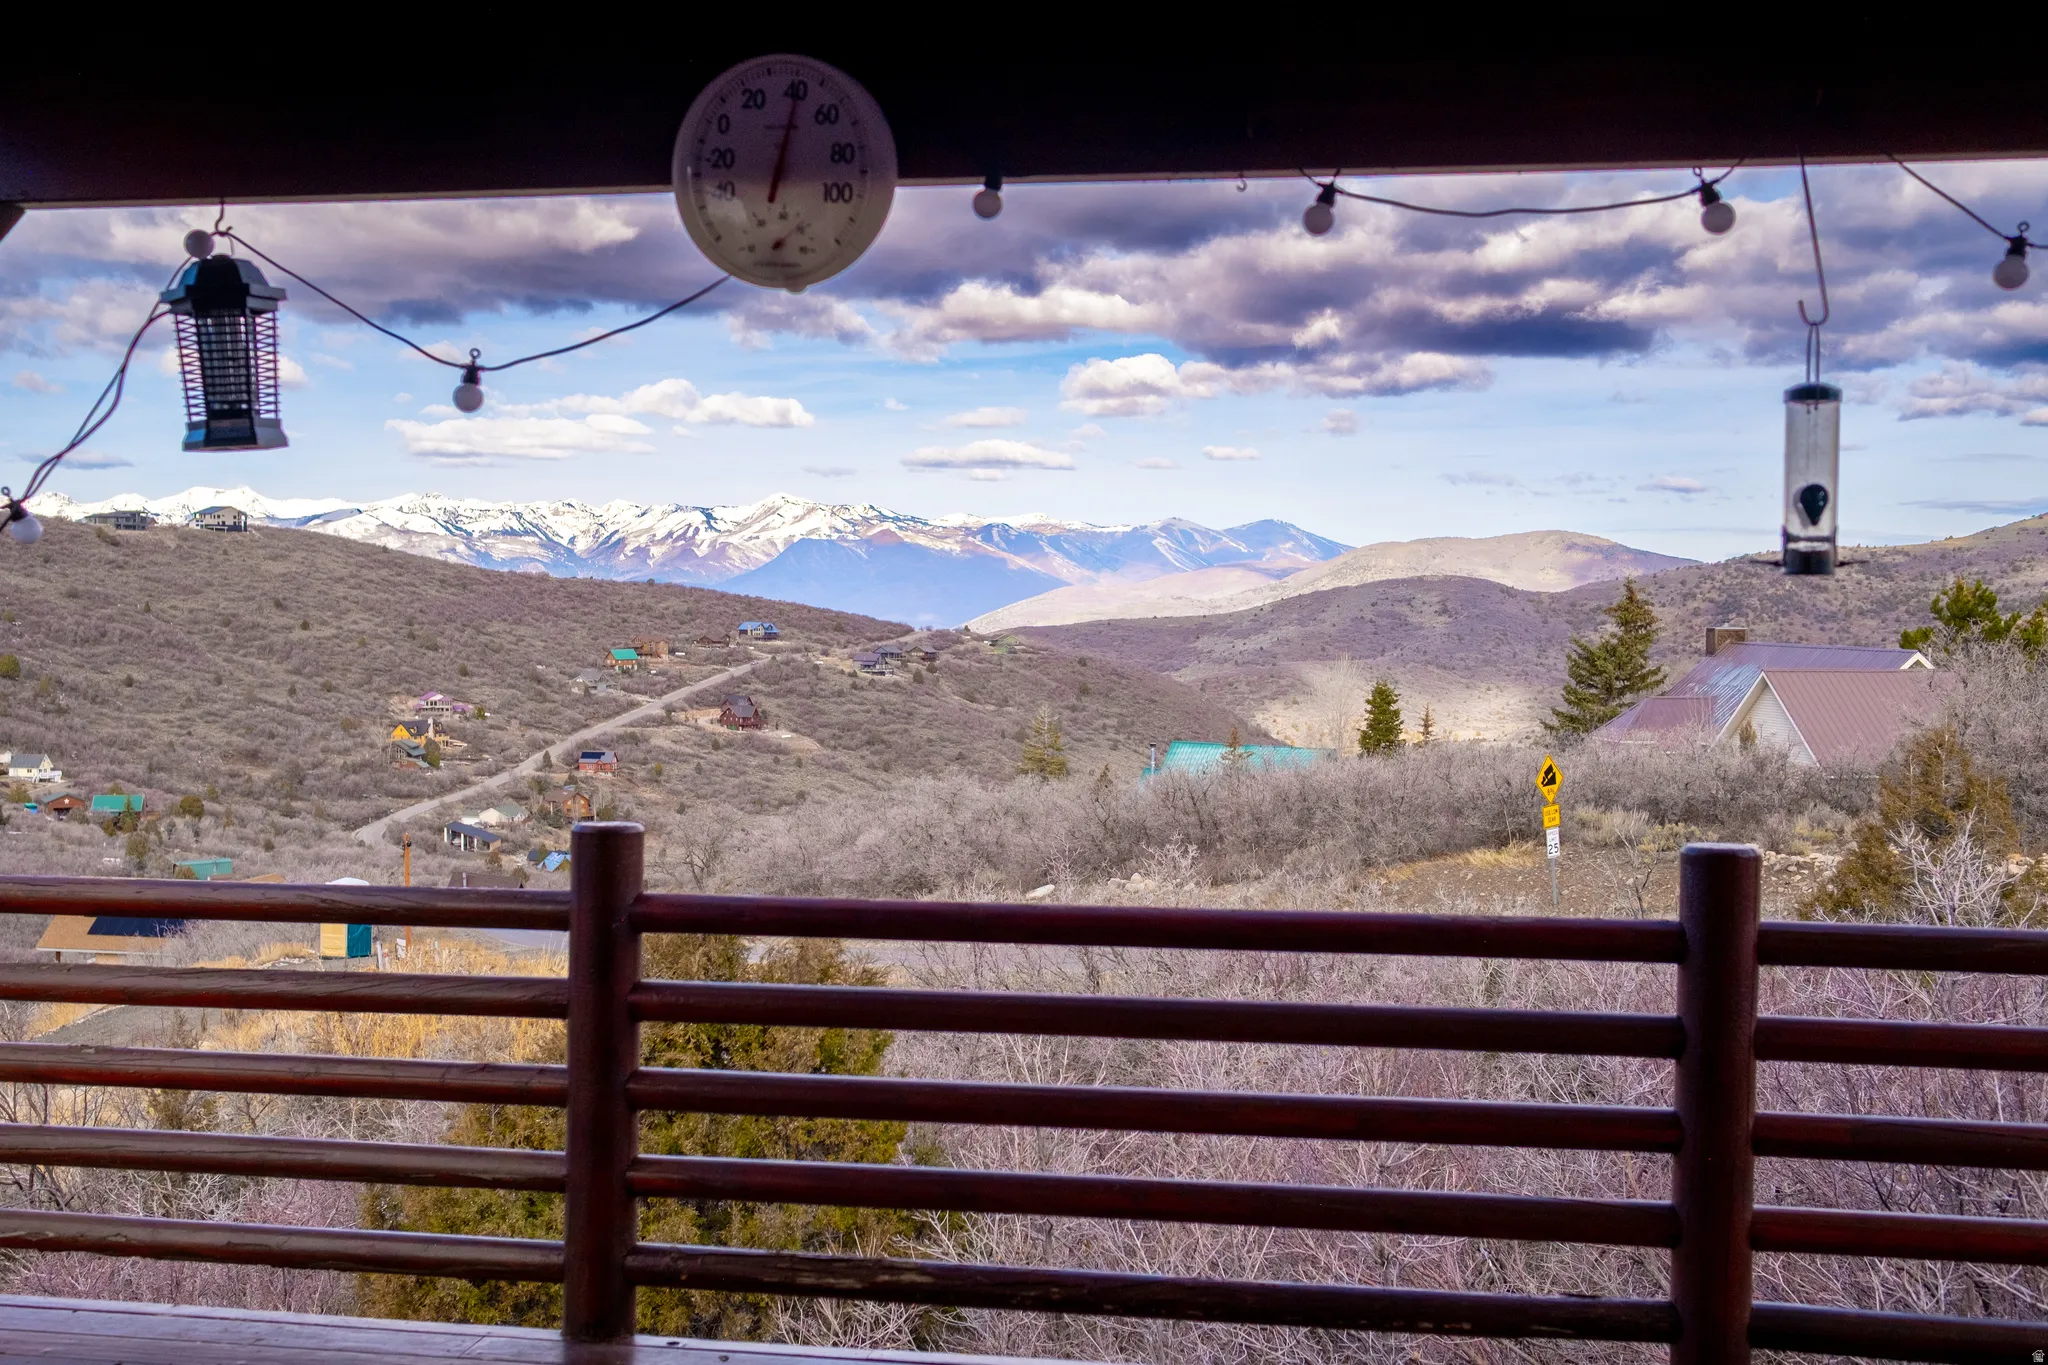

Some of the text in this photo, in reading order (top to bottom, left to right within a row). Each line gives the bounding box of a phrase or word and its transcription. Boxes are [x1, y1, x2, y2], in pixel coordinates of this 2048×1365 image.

[742, 88, 766, 110] 20
[784, 79, 809, 101] 40
[717, 113, 730, 135] 0
[815, 103, 839, 125] 60
[705, 147, 735, 169] -20
[830, 142, 855, 165] 80
[823, 182, 853, 203] 100
[1548, 843, 1559, 854] 25
